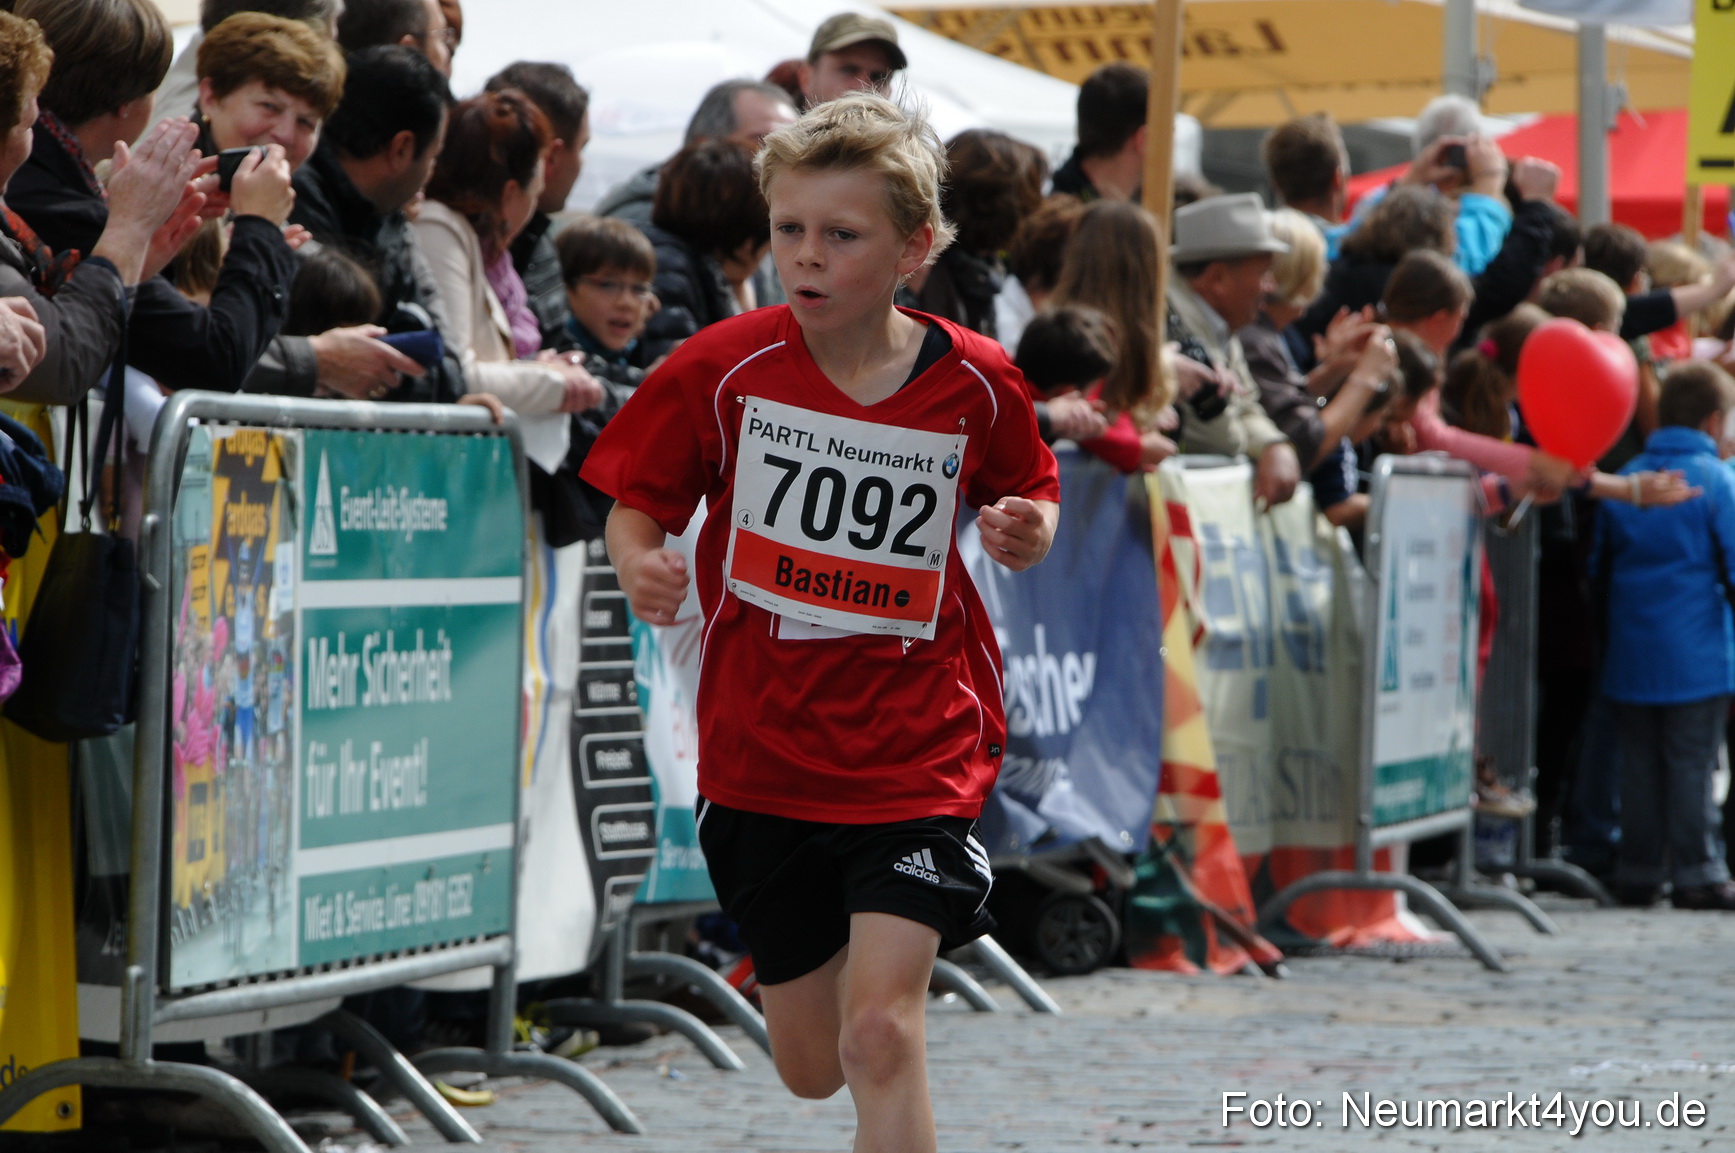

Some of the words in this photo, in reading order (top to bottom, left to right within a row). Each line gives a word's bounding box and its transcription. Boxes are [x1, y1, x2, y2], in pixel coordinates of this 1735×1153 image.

[748, 417, 820, 453] PARTL
[826, 437, 934, 473] Neumarkt
[742, 513, 750, 526] 4
[763, 453, 937, 557] 7092
[774, 555, 891, 608] Bastian
[929, 553, 941, 566] M
[307, 631, 360, 710] Mehr
[362, 628, 452, 706] Sicherheit
[306, 740, 337, 818] für
[339, 738, 367, 815] Ihr
[370, 737, 429, 812] Event!
[893, 861, 940, 884] adidas
